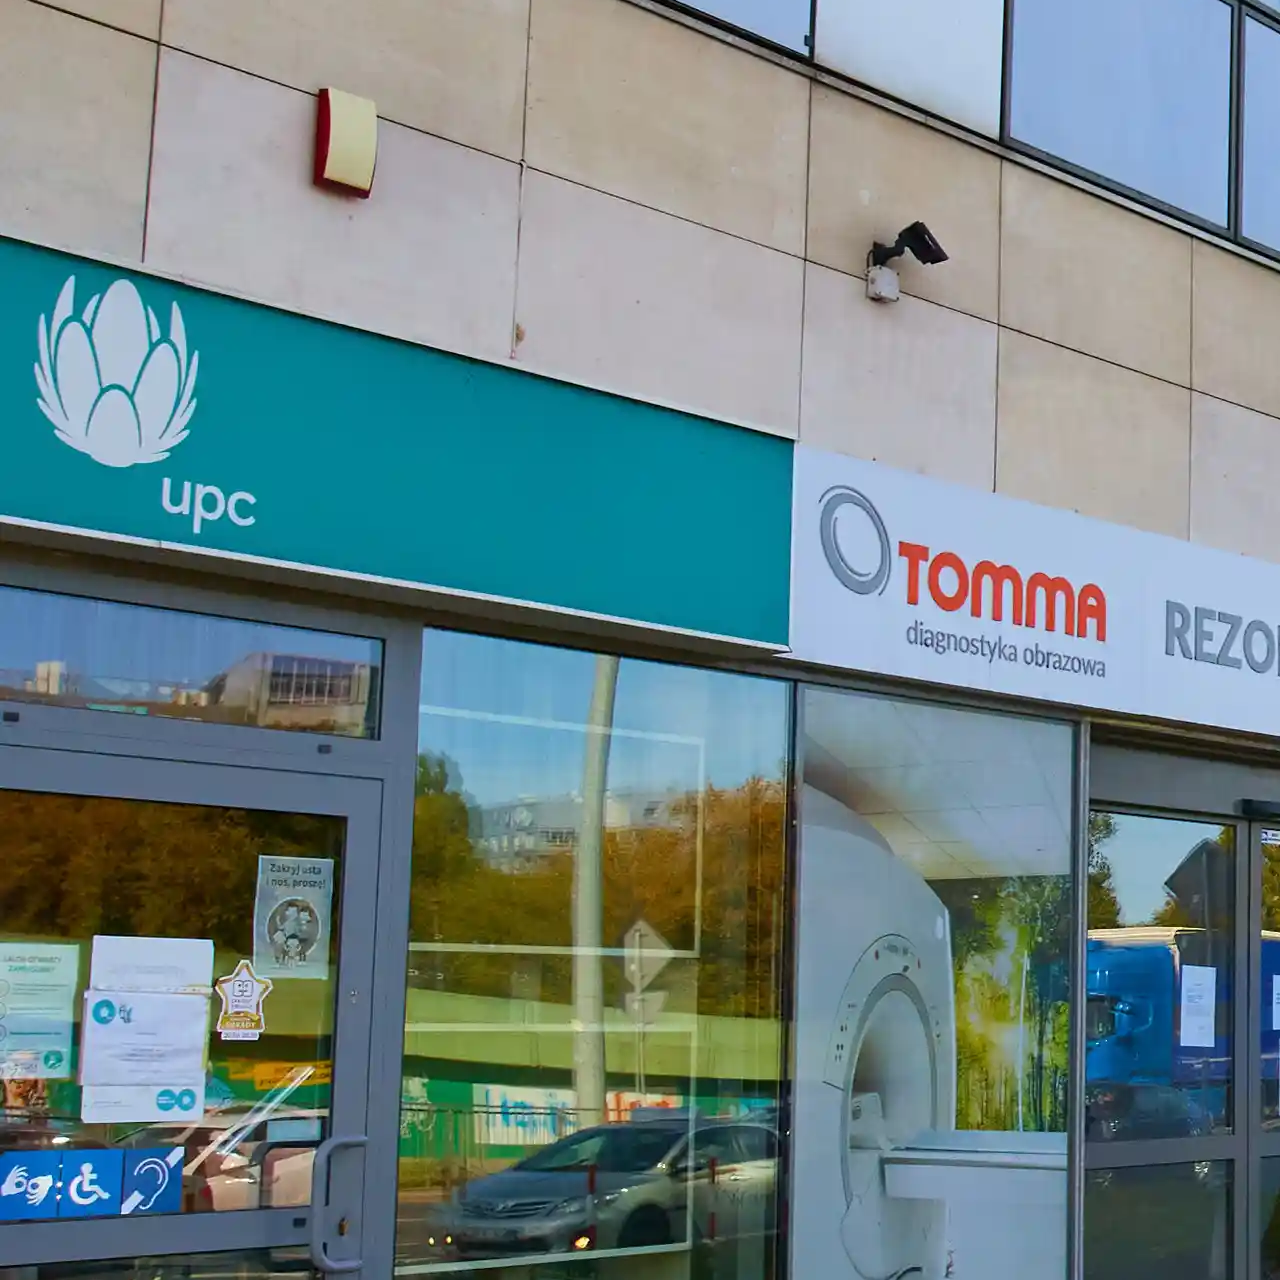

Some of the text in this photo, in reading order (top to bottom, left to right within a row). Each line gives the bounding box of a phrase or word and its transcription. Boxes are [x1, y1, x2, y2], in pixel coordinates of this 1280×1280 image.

[161, 475, 257, 534] upc
[897, 540, 1107, 642] TOMMA
[906, 619, 1107, 680] diagnostyka obrazowa
